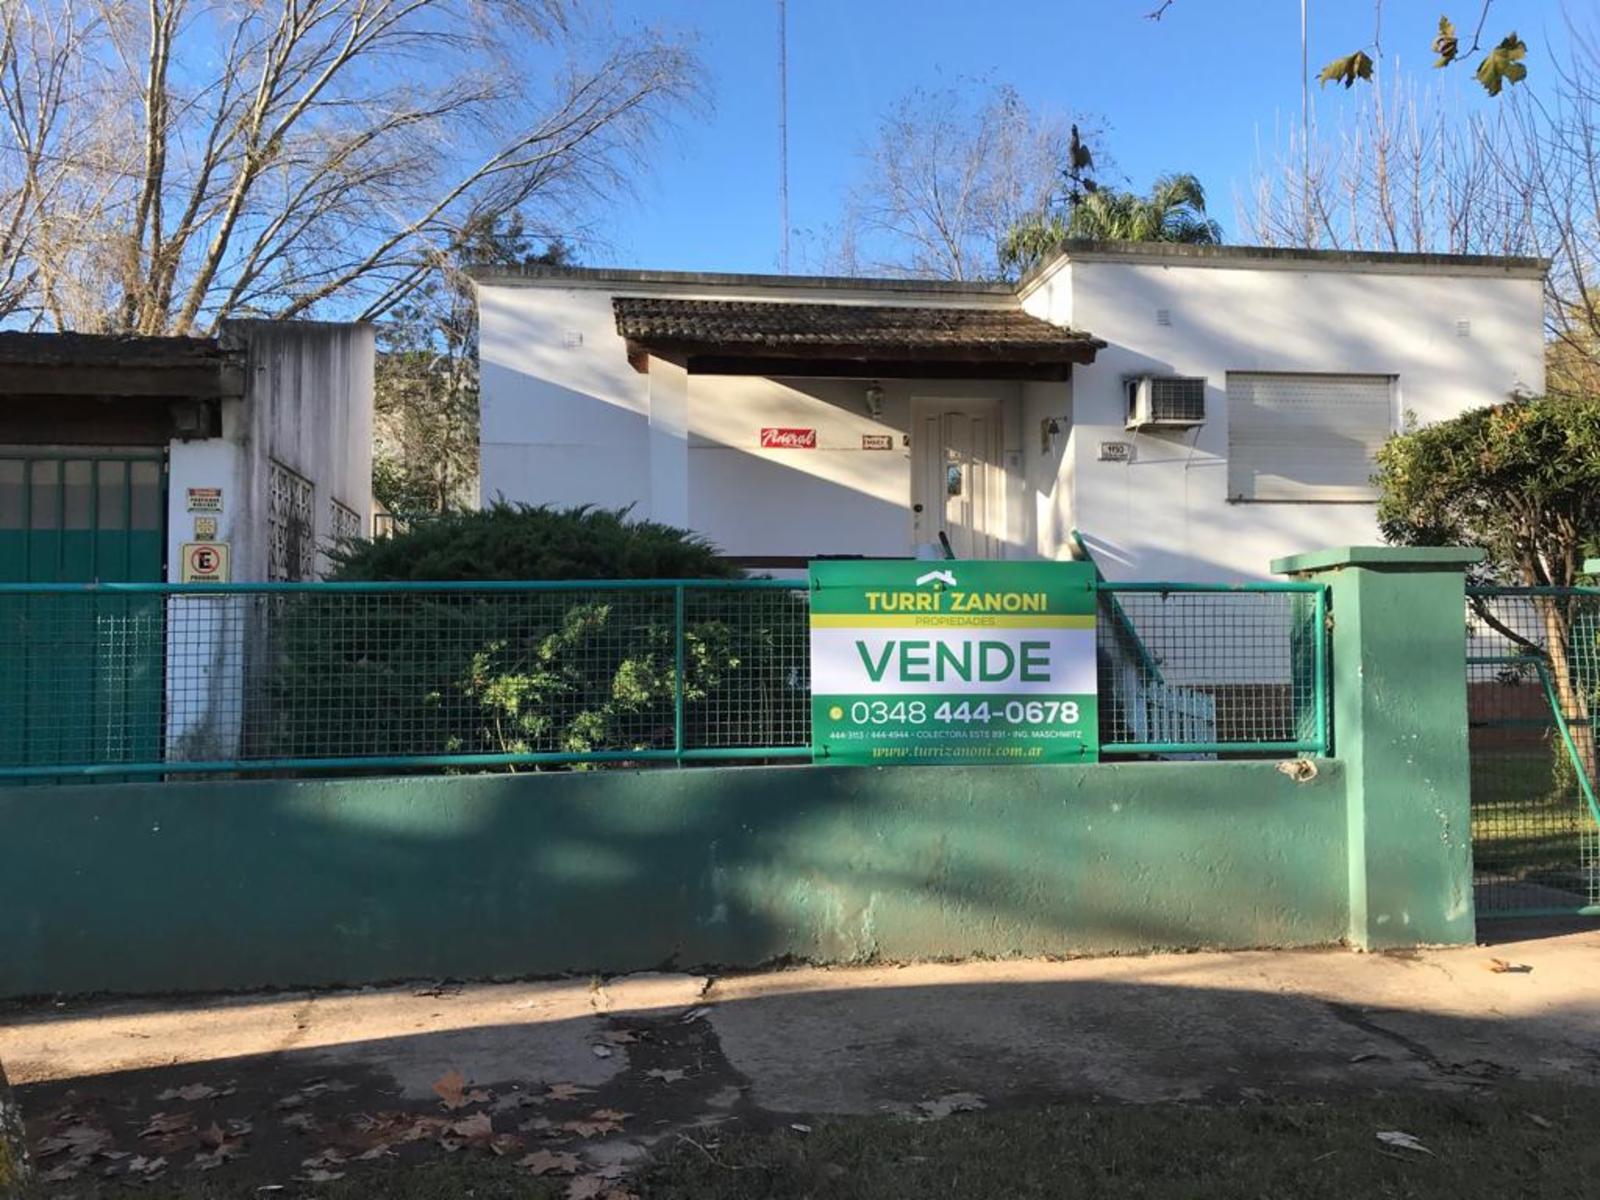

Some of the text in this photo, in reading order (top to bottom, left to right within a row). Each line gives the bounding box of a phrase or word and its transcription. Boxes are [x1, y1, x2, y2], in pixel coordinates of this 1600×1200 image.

[199, 551, 212, 569] E
[951, 592, 1048, 612] ZANONI
[915, 616, 996, 627] PROPIEDADES
[855, 640, 1051, 683] VENDE
[851, 701, 1080, 724] 0348 444-0678
[916, 730, 967, 739] COLECTORA
[968, 730, 989, 739] ESTE
[1031, 730, 1083, 739] MASCHWITZ
[872, 744, 1043, 758] www.turrizanoni.com.ar
